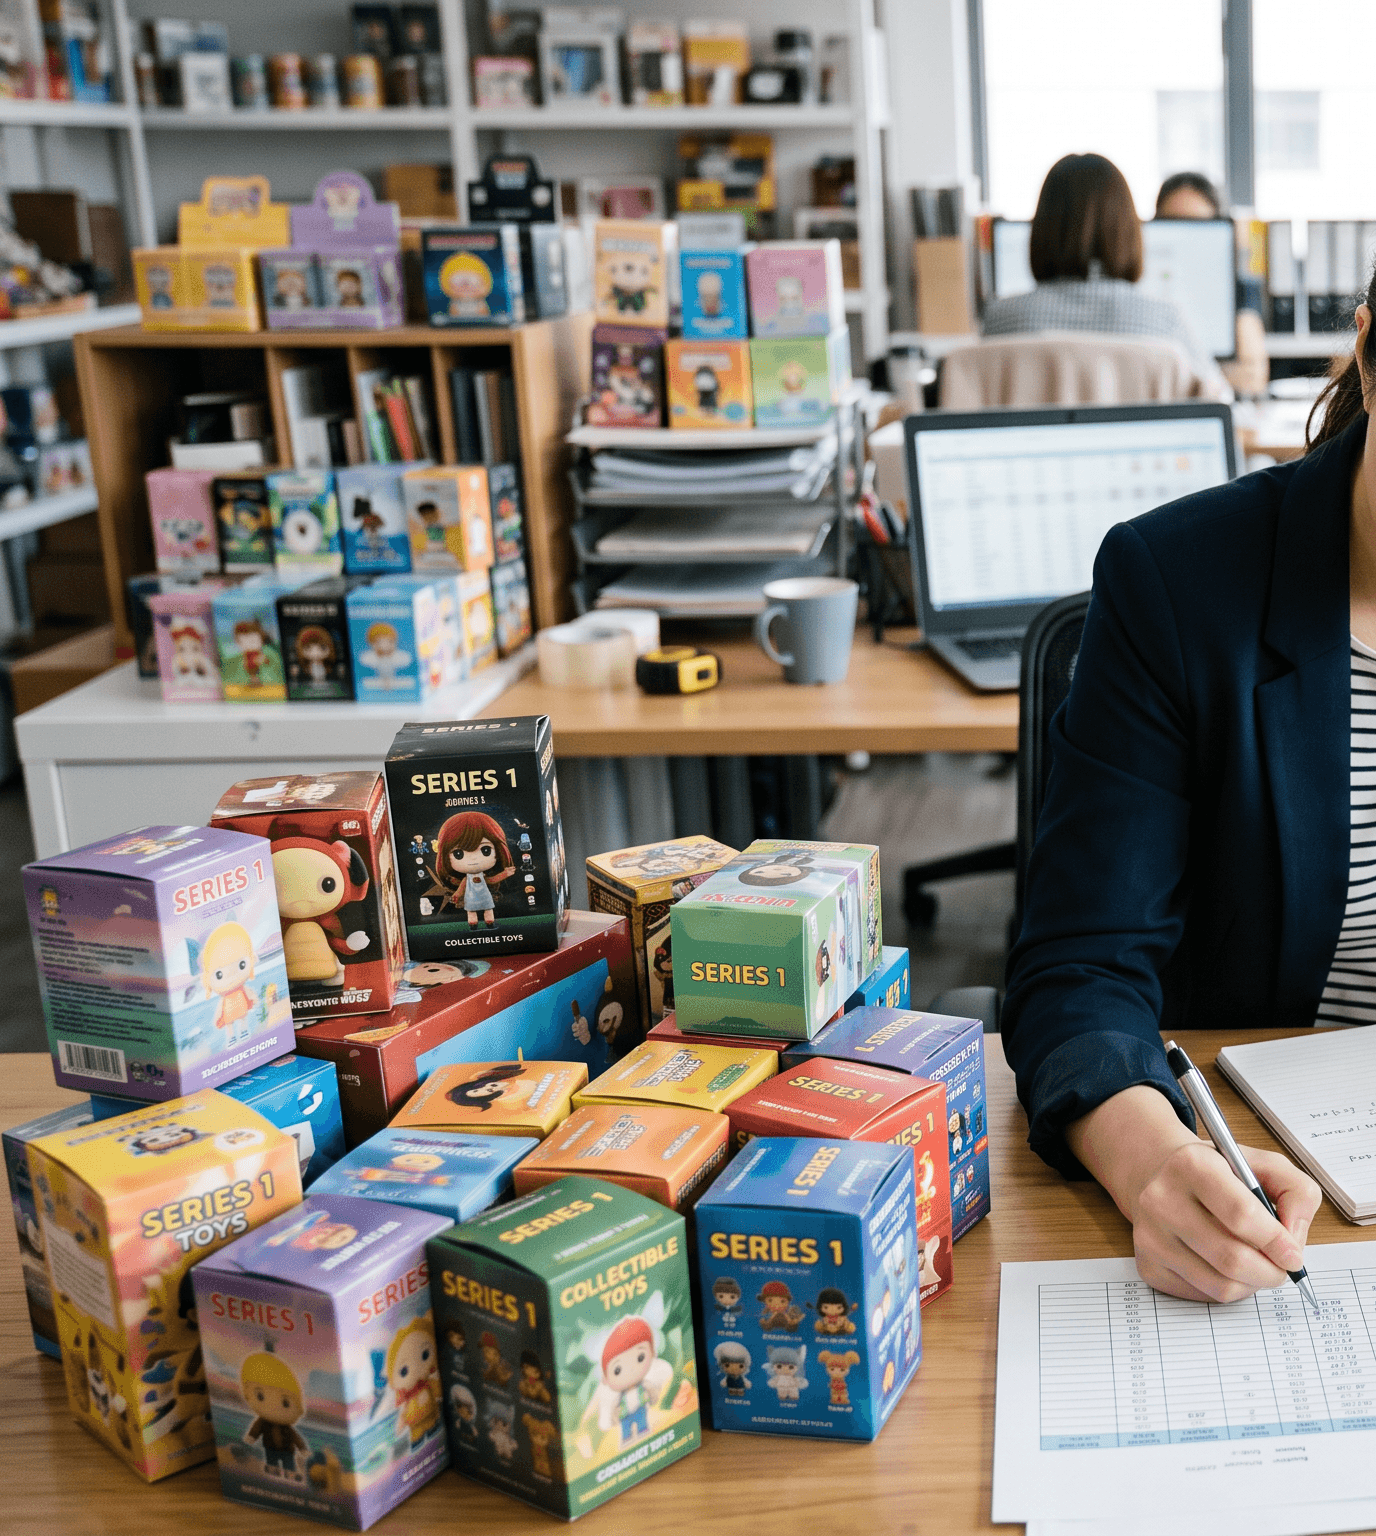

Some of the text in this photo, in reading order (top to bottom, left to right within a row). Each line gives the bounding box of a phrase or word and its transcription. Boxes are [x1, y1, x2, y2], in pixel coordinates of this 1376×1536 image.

[410, 768, 517, 795] SERIES 1
[173, 866, 248, 914] SERIES
[252, 859, 264, 881] 1
[444, 934, 524, 947] COLLECTIBLE TOYS
[690, 961, 786, 987] SERIES 1
[787, 1075, 885, 1104] SERIES 1
[926, 1112, 935, 1134] 1
[794, 1146, 842, 1188] SERIES
[141, 1171, 275, 1239] SERIES 1
[498, 1191, 614, 1245] SERIES 1
[175, 1212, 249, 1251] TOYS
[710, 1232, 843, 1266] SERIES 1
[559, 1236, 679, 1309] COLLECTIBLE
[600, 1274, 649, 1311] TOYS
[357, 1262, 430, 1325] SERIES
[442, 1270, 537, 1329] SERIES 1
[211, 1293, 314, 1336] SERIES 1
